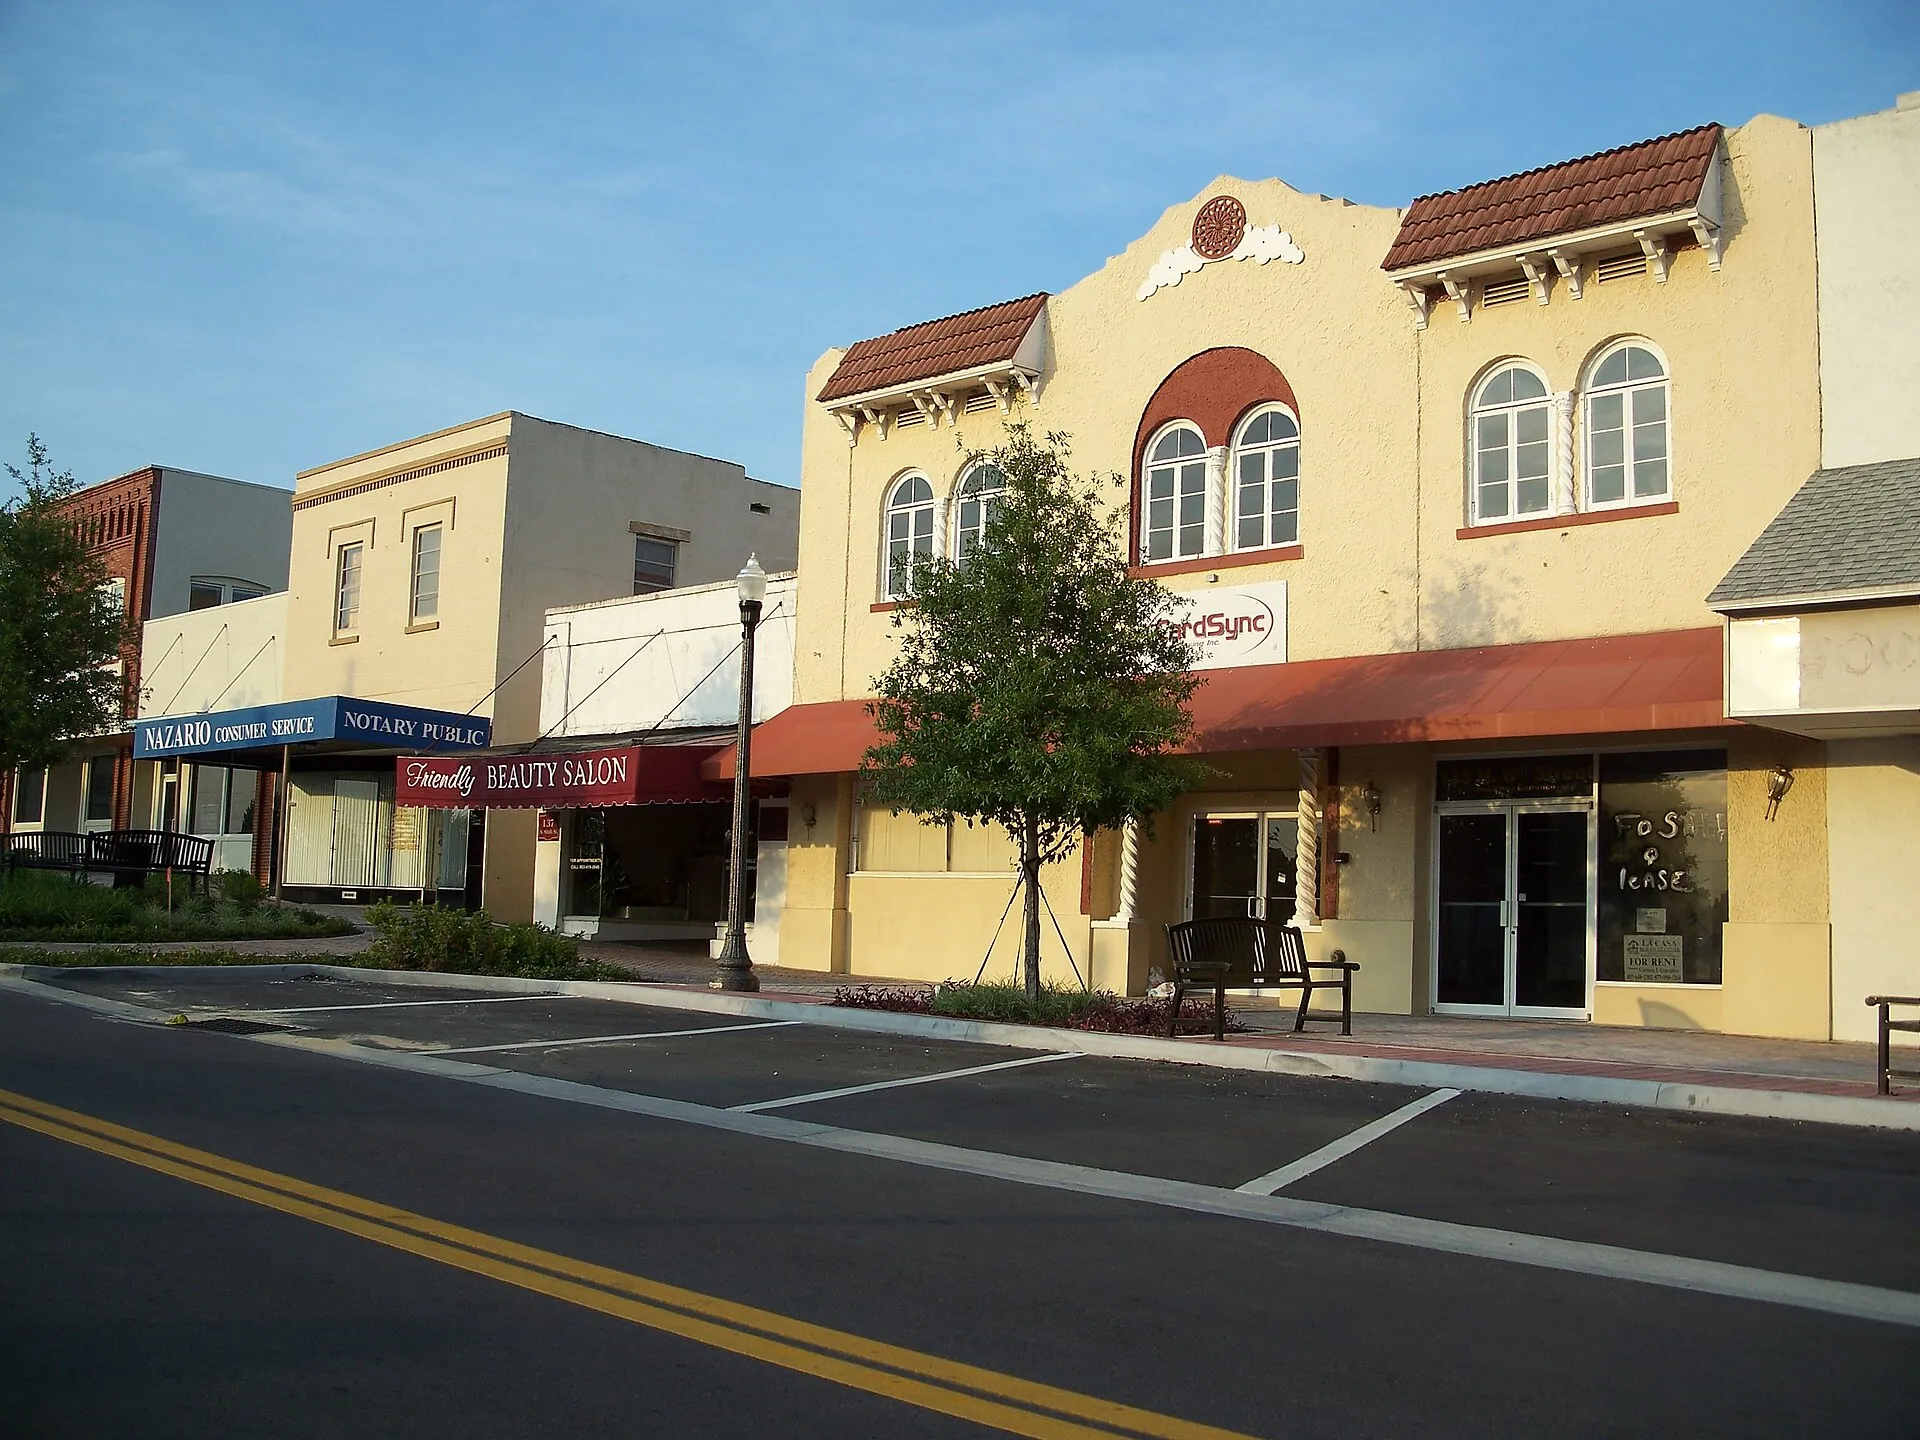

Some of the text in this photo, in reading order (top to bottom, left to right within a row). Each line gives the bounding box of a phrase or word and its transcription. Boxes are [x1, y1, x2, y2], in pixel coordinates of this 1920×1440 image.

[145, 716, 315, 750] NAZARIO CONSUMER SERVICE
[344, 711, 485, 746] NOTARY PUBLIC
[406, 755, 628, 797] Friendly BEAUTY SALON
[543, 819, 554, 828] 137
[1629, 957, 1677, 966] FOR RENT
